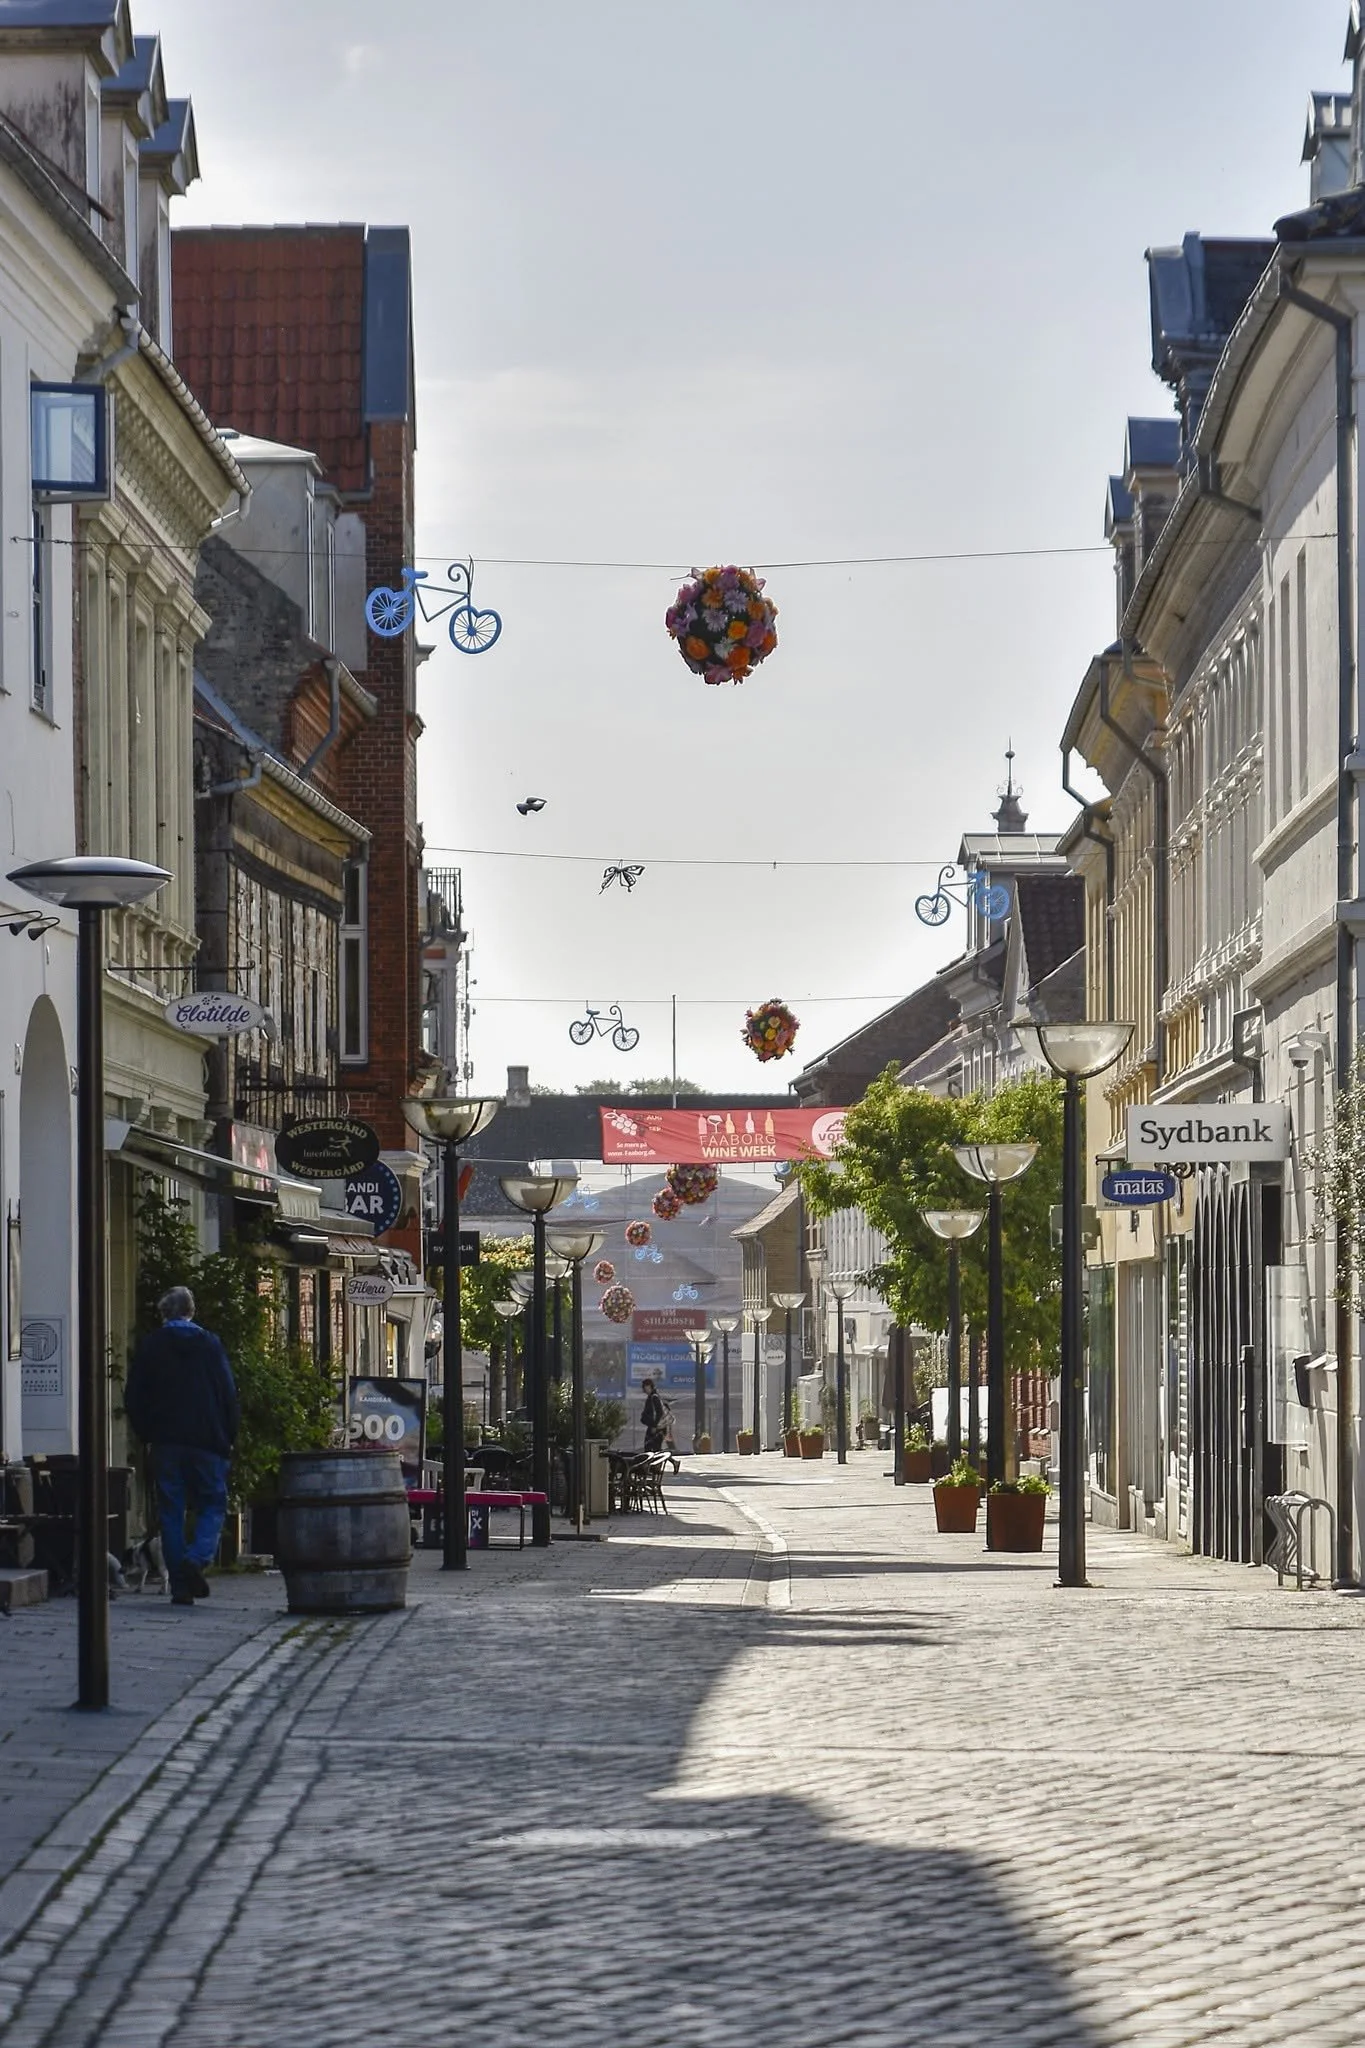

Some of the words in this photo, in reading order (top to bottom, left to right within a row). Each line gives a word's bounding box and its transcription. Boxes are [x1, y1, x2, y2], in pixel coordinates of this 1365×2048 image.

[176, 1004, 251, 1022] Clotilde
[286, 1120, 368, 1139] WESTERGÅRD
[818, 1133, 845, 1141] VOR
[1140, 1119, 1273, 1150] Sydbank
[700, 1133, 776, 1146] FAABORG
[303, 1149, 342, 1158] Interflora
[702, 1146, 738, 1157] WINE
[741, 1145, 777, 1156] WEEK
[291, 1160, 365, 1178] WESTERGÅRD
[345, 1182, 379, 1194] ANDI
[1113, 1178, 1165, 1195] matas
[345, 1195, 384, 1215] AR
[346, 1414, 405, 1441] 500
